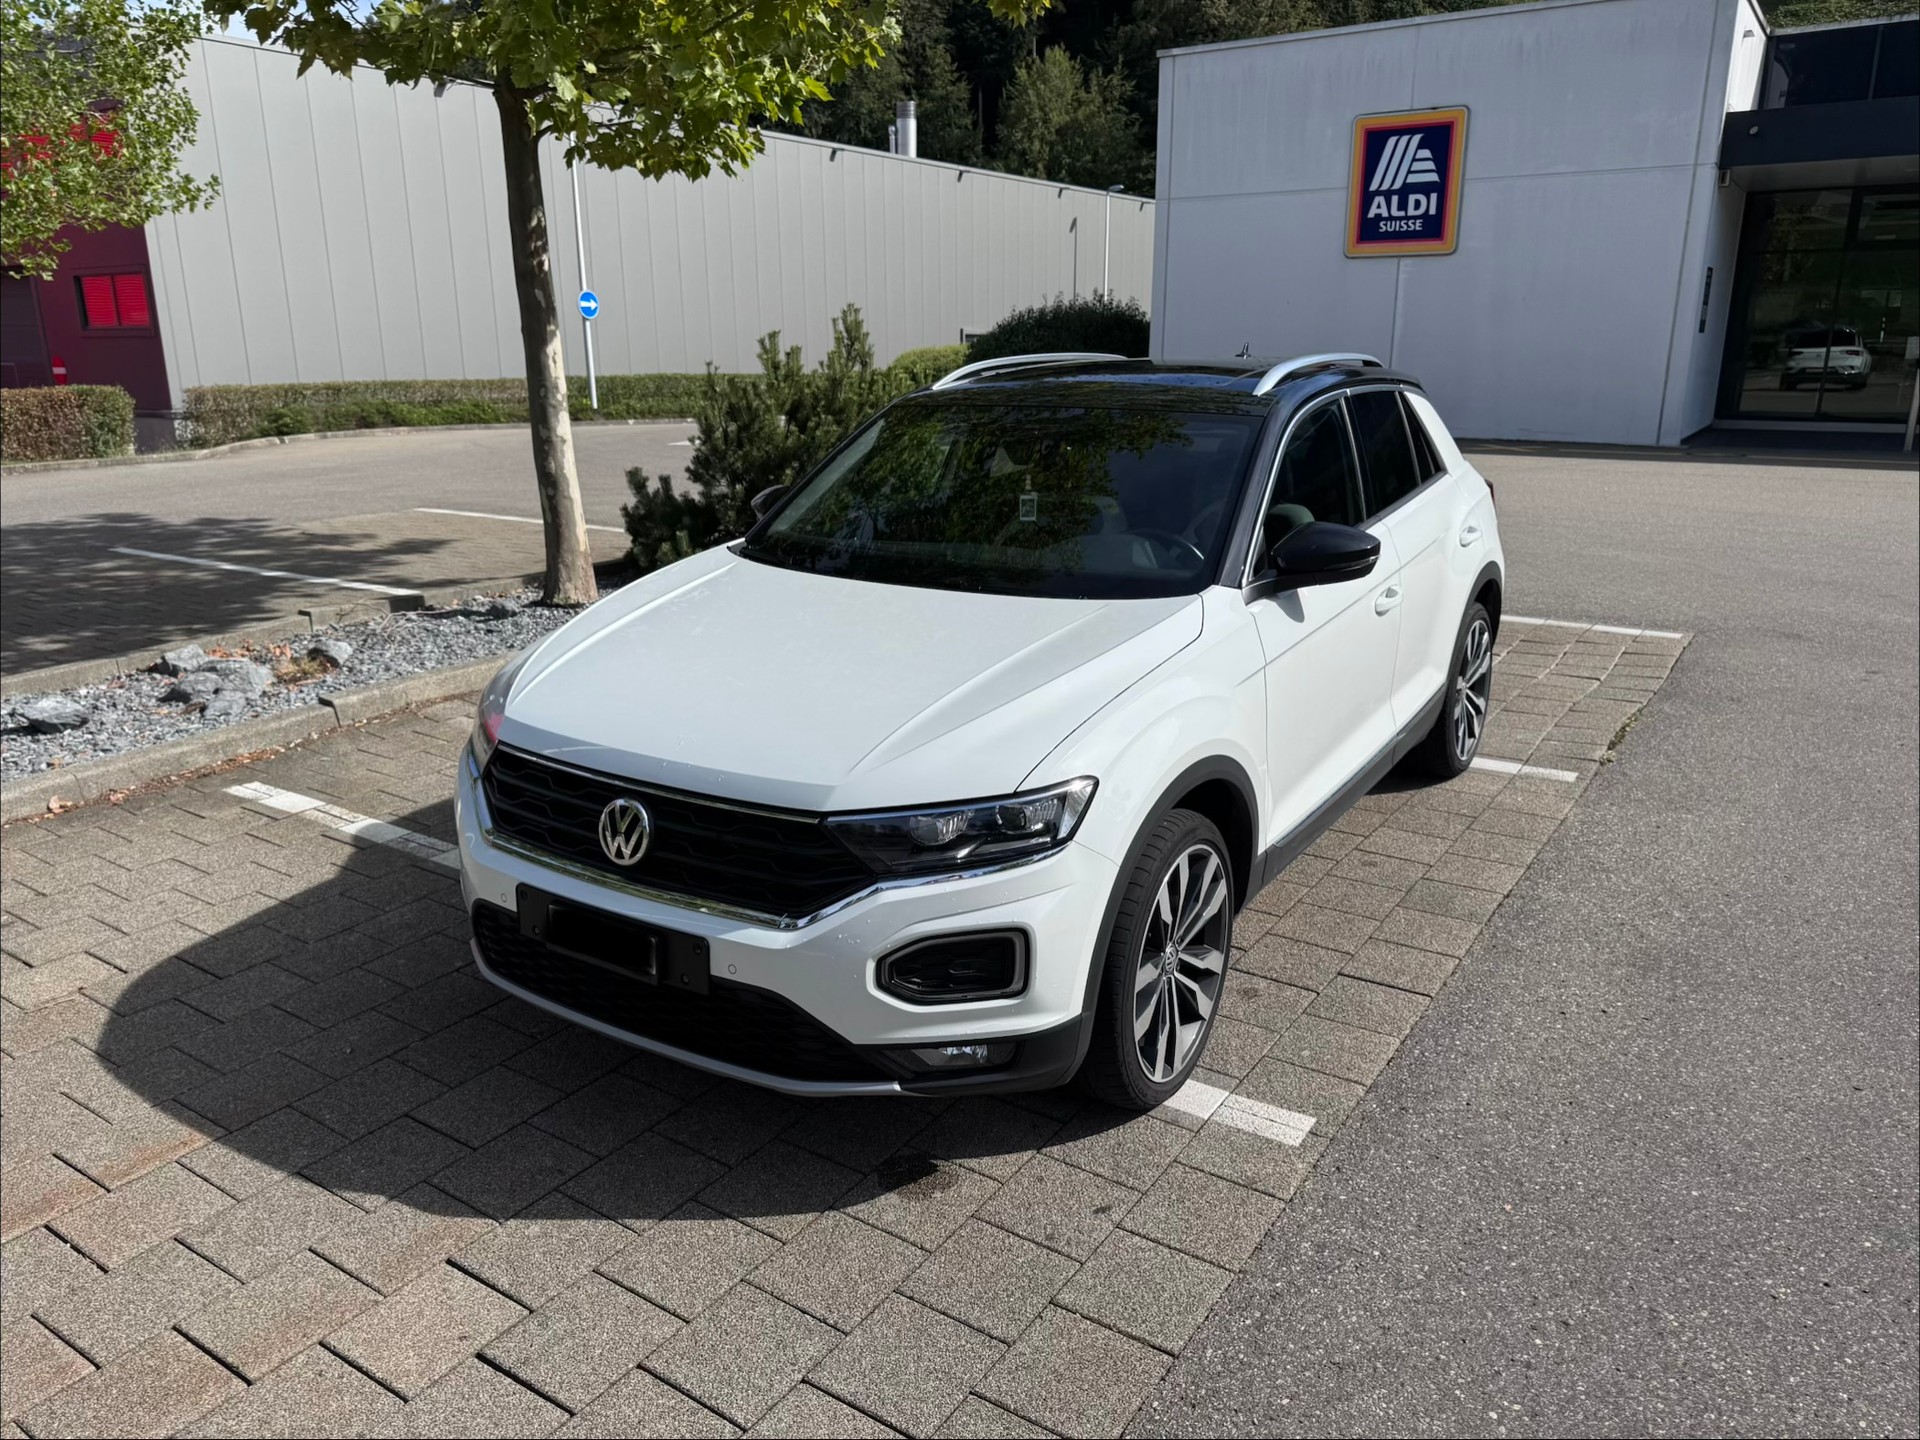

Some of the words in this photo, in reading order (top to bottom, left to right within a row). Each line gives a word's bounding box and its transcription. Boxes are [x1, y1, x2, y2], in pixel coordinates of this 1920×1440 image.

[1367, 192, 1438, 218] ALDI
[1379, 219, 1423, 232] SUISSE
[600, 800, 648, 864] VW
